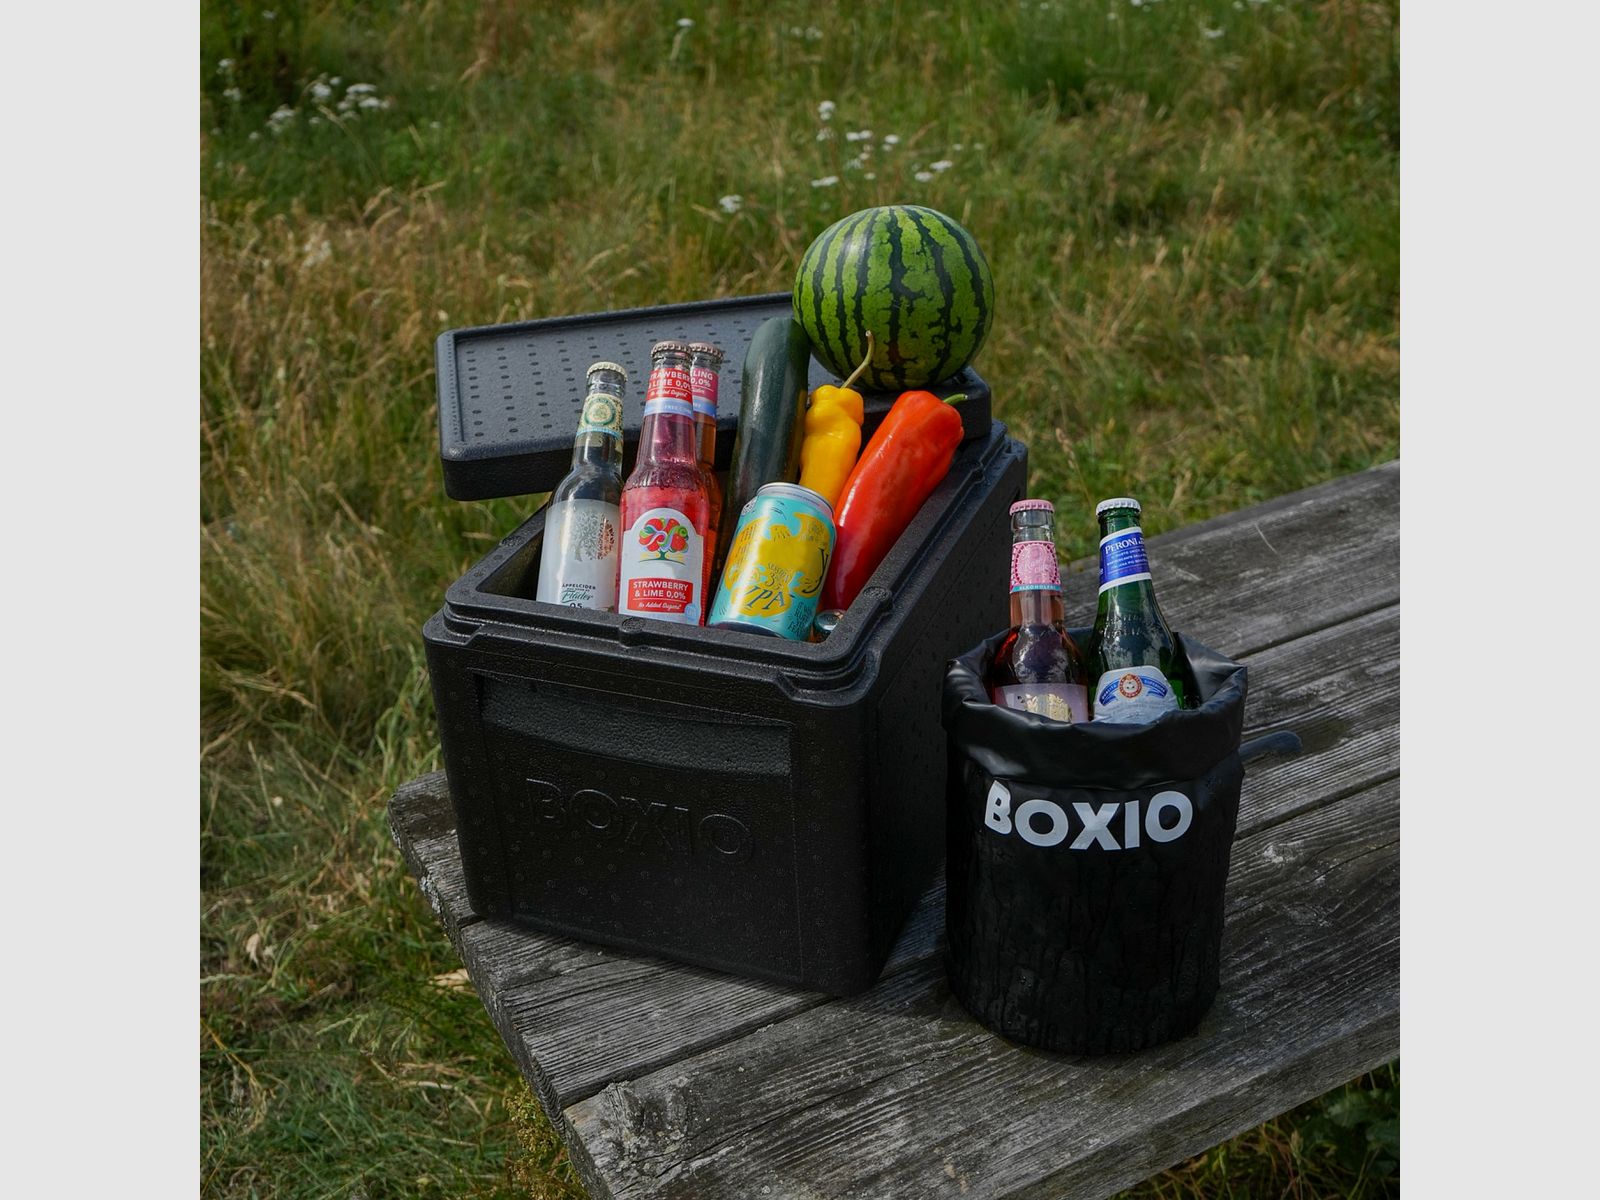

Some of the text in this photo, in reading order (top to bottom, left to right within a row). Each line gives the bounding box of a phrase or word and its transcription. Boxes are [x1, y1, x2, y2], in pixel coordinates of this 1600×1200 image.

[1105, 537, 1138, 554] PERONI
[633, 581, 689, 592] STRAWBERRY
[634, 589, 640, 597] &
[643, 589, 664, 597] LIME
[745, 586, 785, 610] IPA
[525, 779, 756, 865] BOXIO
[984, 779, 1194, 851] BOXIO
